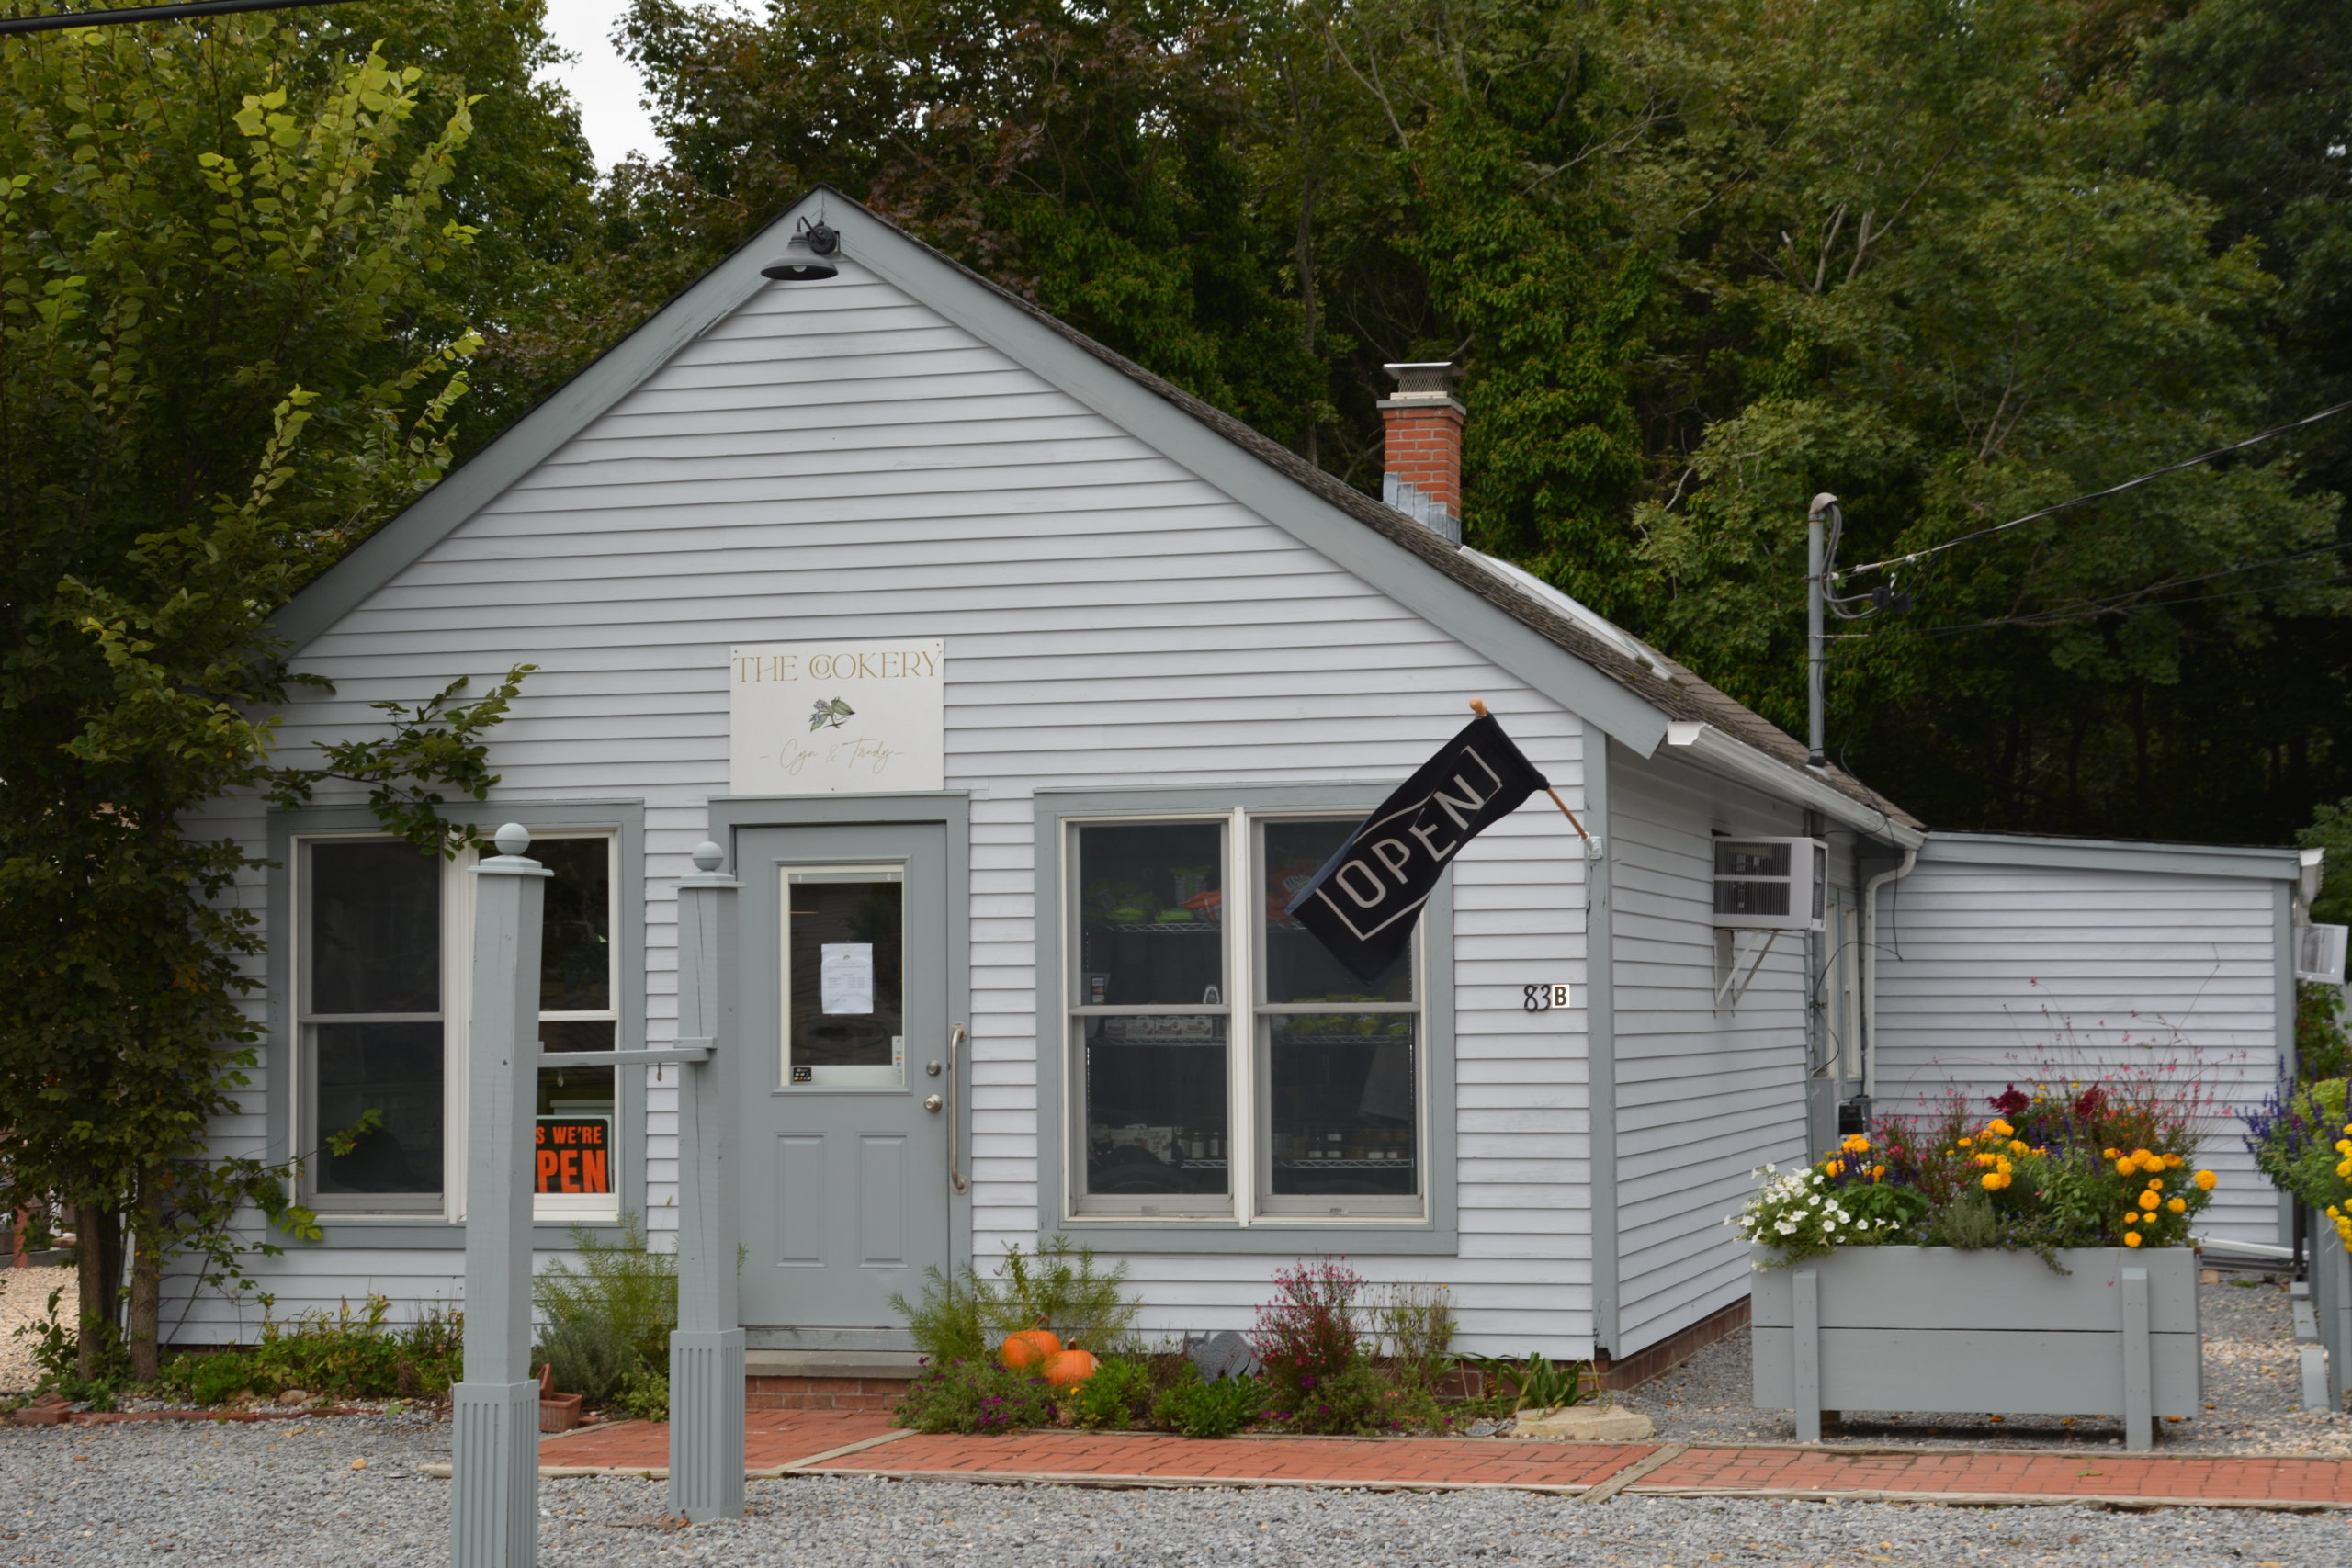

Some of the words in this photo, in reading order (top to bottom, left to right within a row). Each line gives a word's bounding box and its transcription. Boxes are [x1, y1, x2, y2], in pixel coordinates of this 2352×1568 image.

[732, 654, 798, 682] THE
[808, 650, 943, 681] COOKERY
[825, 744, 839, 763] &
[842, 736, 895, 774] Trudy
[1335, 773, 1485, 908] OPEN
[552, 1126, 603, 1145] WE'RE
[536, 1149, 607, 1194] PEN
